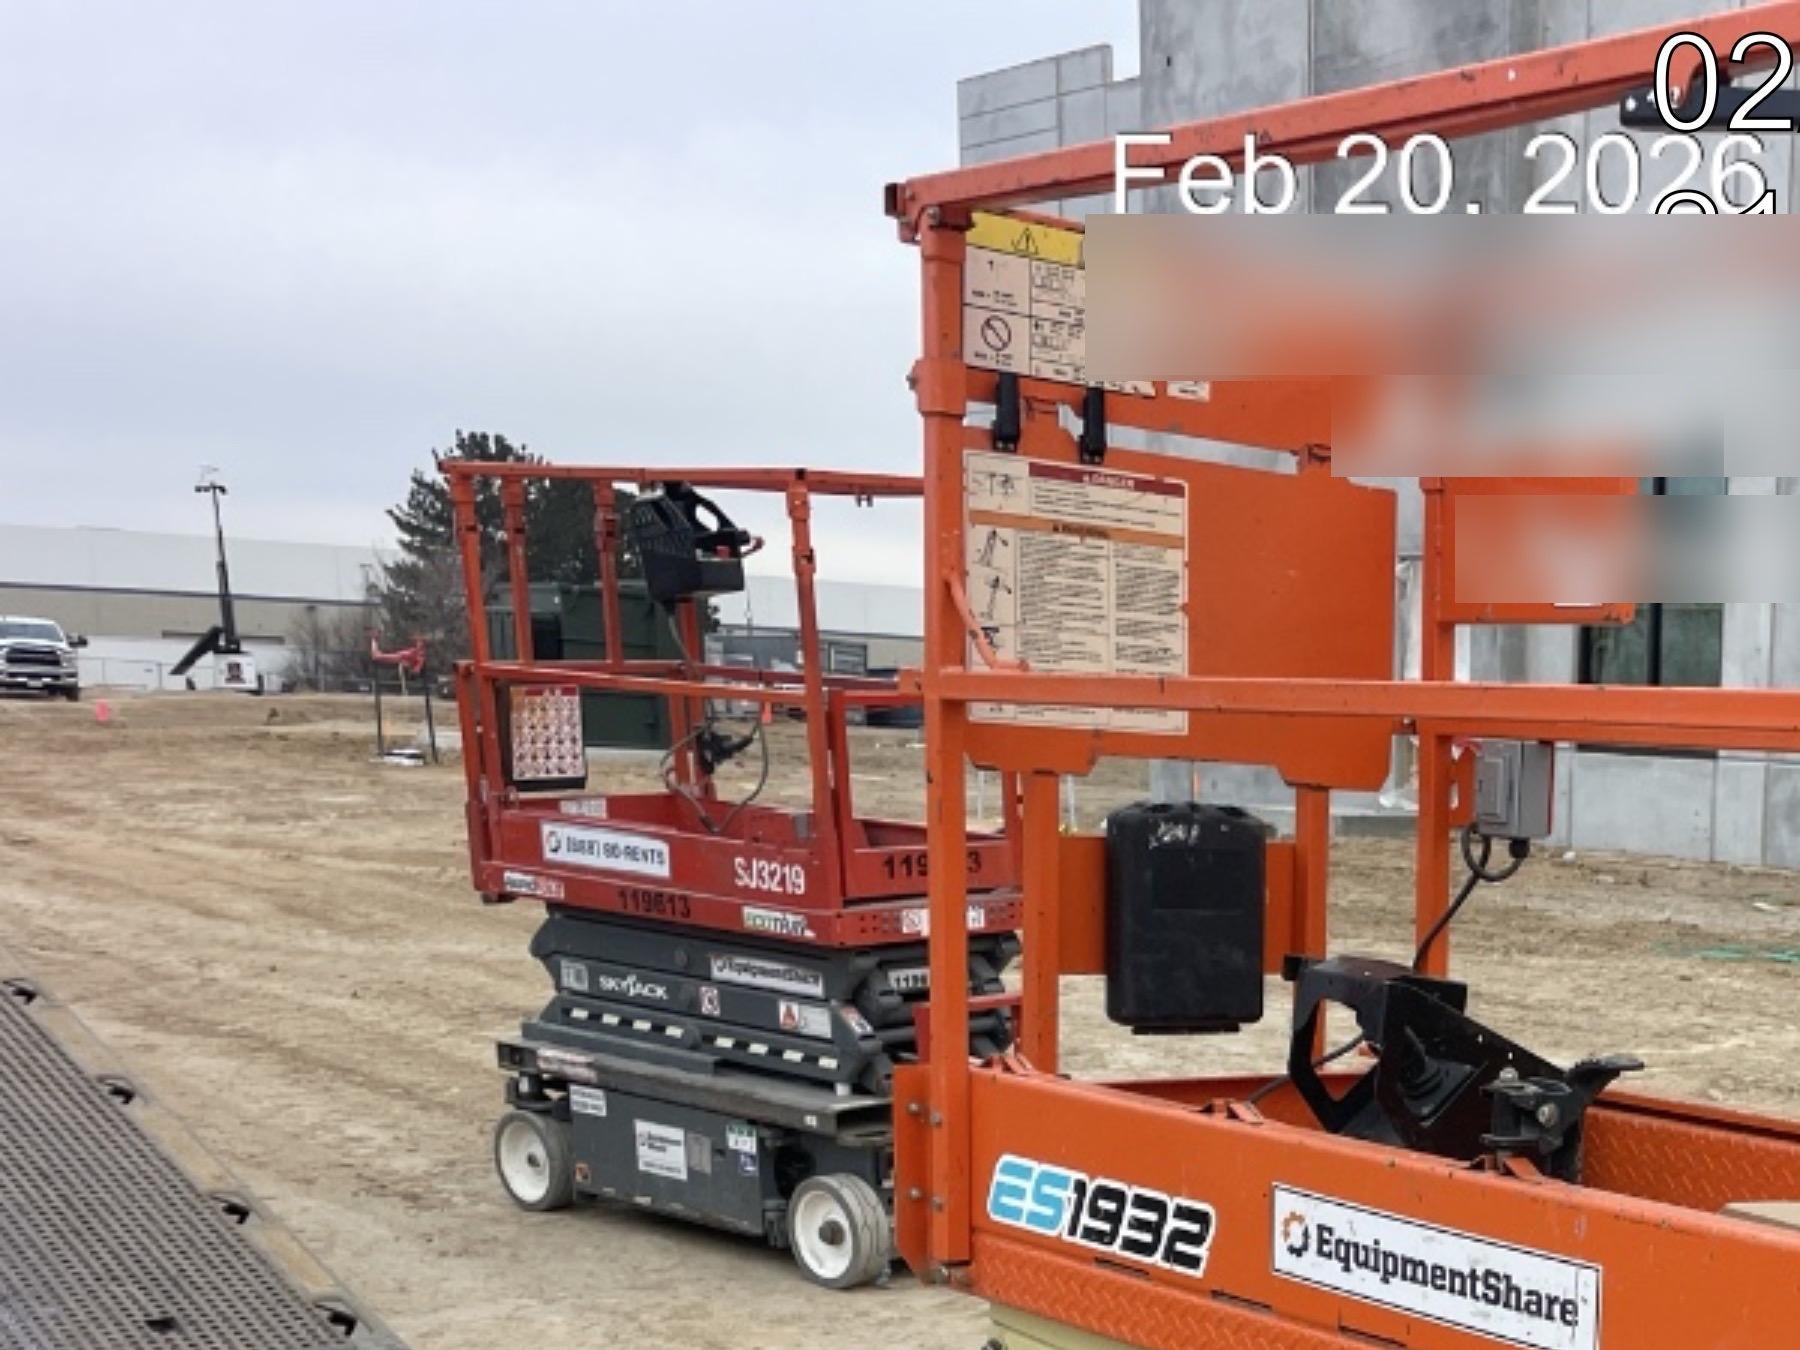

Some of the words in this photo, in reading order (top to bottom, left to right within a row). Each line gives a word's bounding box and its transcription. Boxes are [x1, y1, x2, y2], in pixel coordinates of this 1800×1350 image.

[734, 857, 806, 896] SJ3219
[988, 1155, 1215, 1278] ES1932
[1316, 1223, 1580, 1327] EquipmentShare
